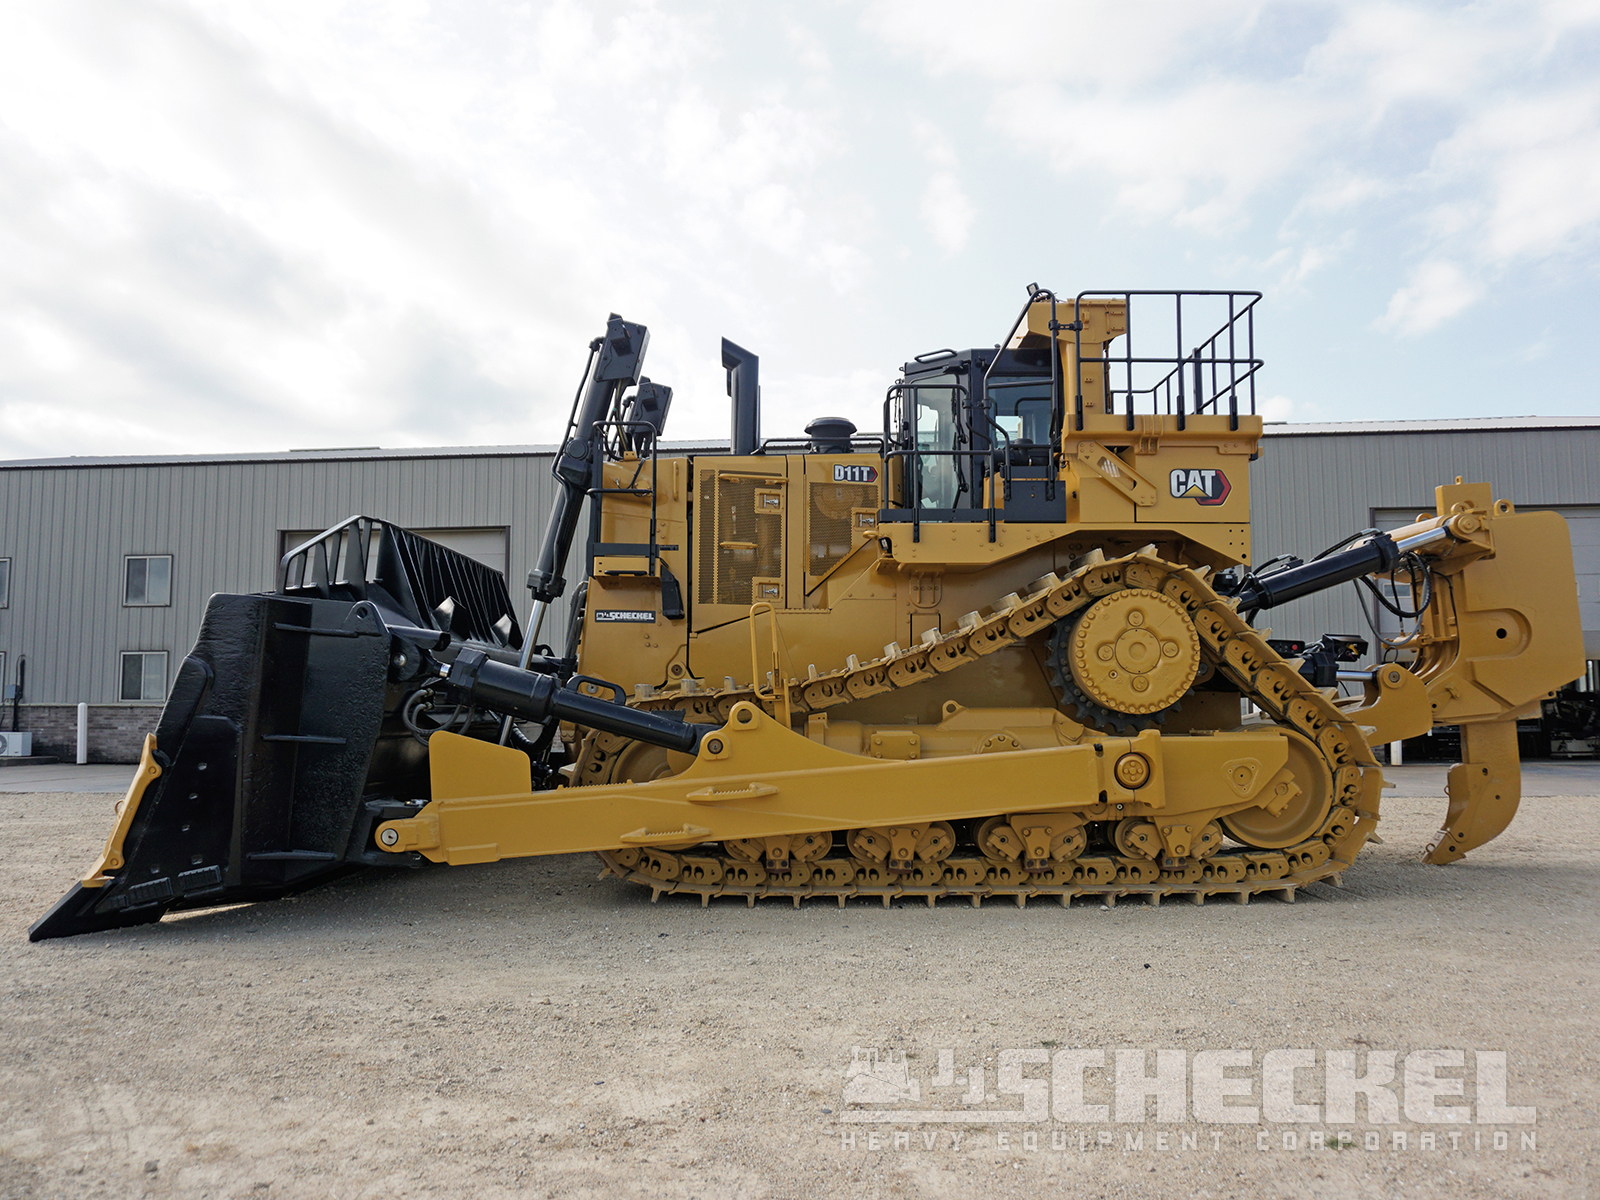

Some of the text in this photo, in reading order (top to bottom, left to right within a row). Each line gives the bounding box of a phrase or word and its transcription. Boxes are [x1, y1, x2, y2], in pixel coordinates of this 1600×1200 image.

[834, 464, 870, 482] D11T
[1170, 469, 1216, 498] CAT
[609, 611, 655, 621] SCHECKEL
